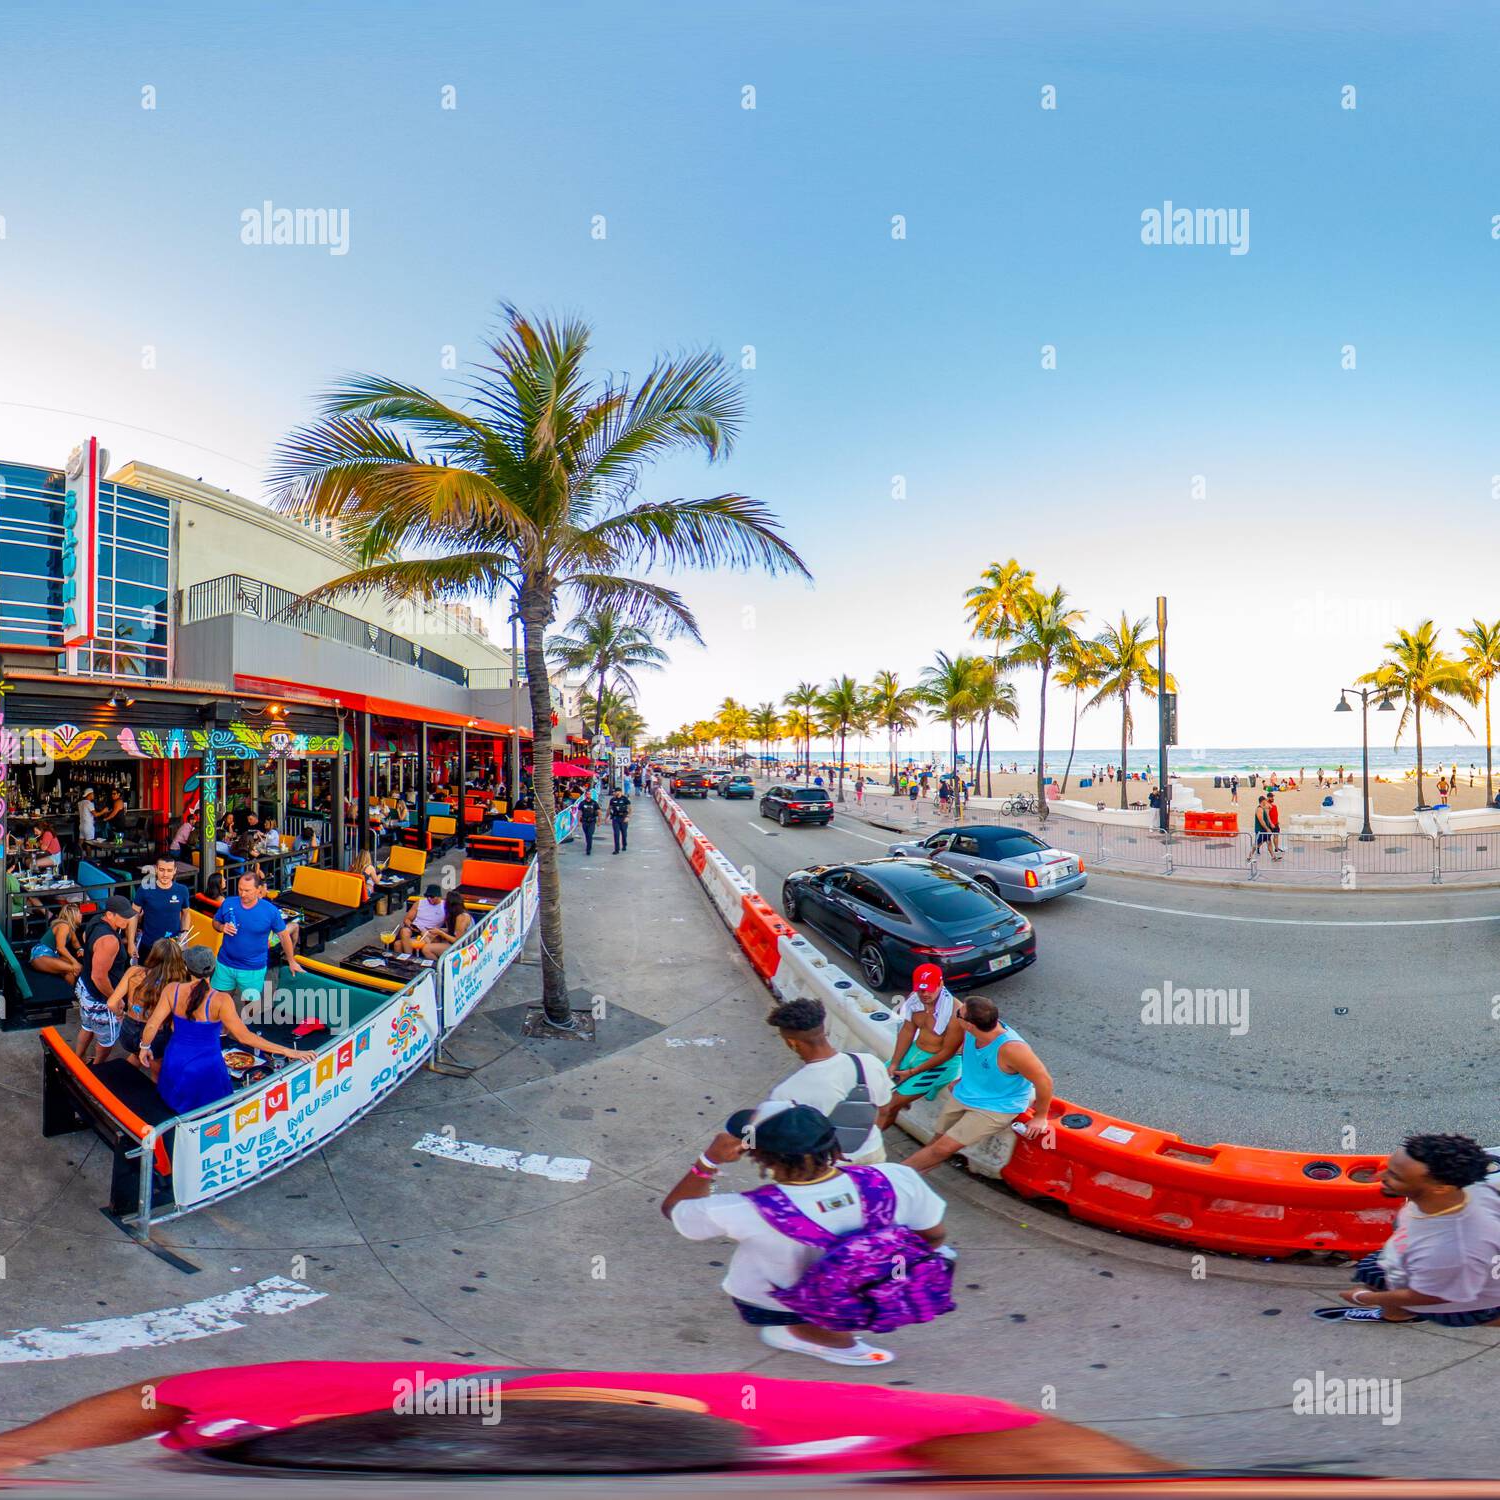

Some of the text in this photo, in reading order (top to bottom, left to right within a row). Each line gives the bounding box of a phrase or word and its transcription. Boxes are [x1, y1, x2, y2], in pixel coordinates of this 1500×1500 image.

[616, 757, 629, 765] 30
[454, 978, 477, 1007] ALL DAY
[455, 979, 483, 1017] ALL NIGHT
[202, 1076, 354, 1173] LIVE MUSIC
[200, 1127, 315, 1193] ALL NIGHT
[201, 1131, 300, 1183] ALL DAY
